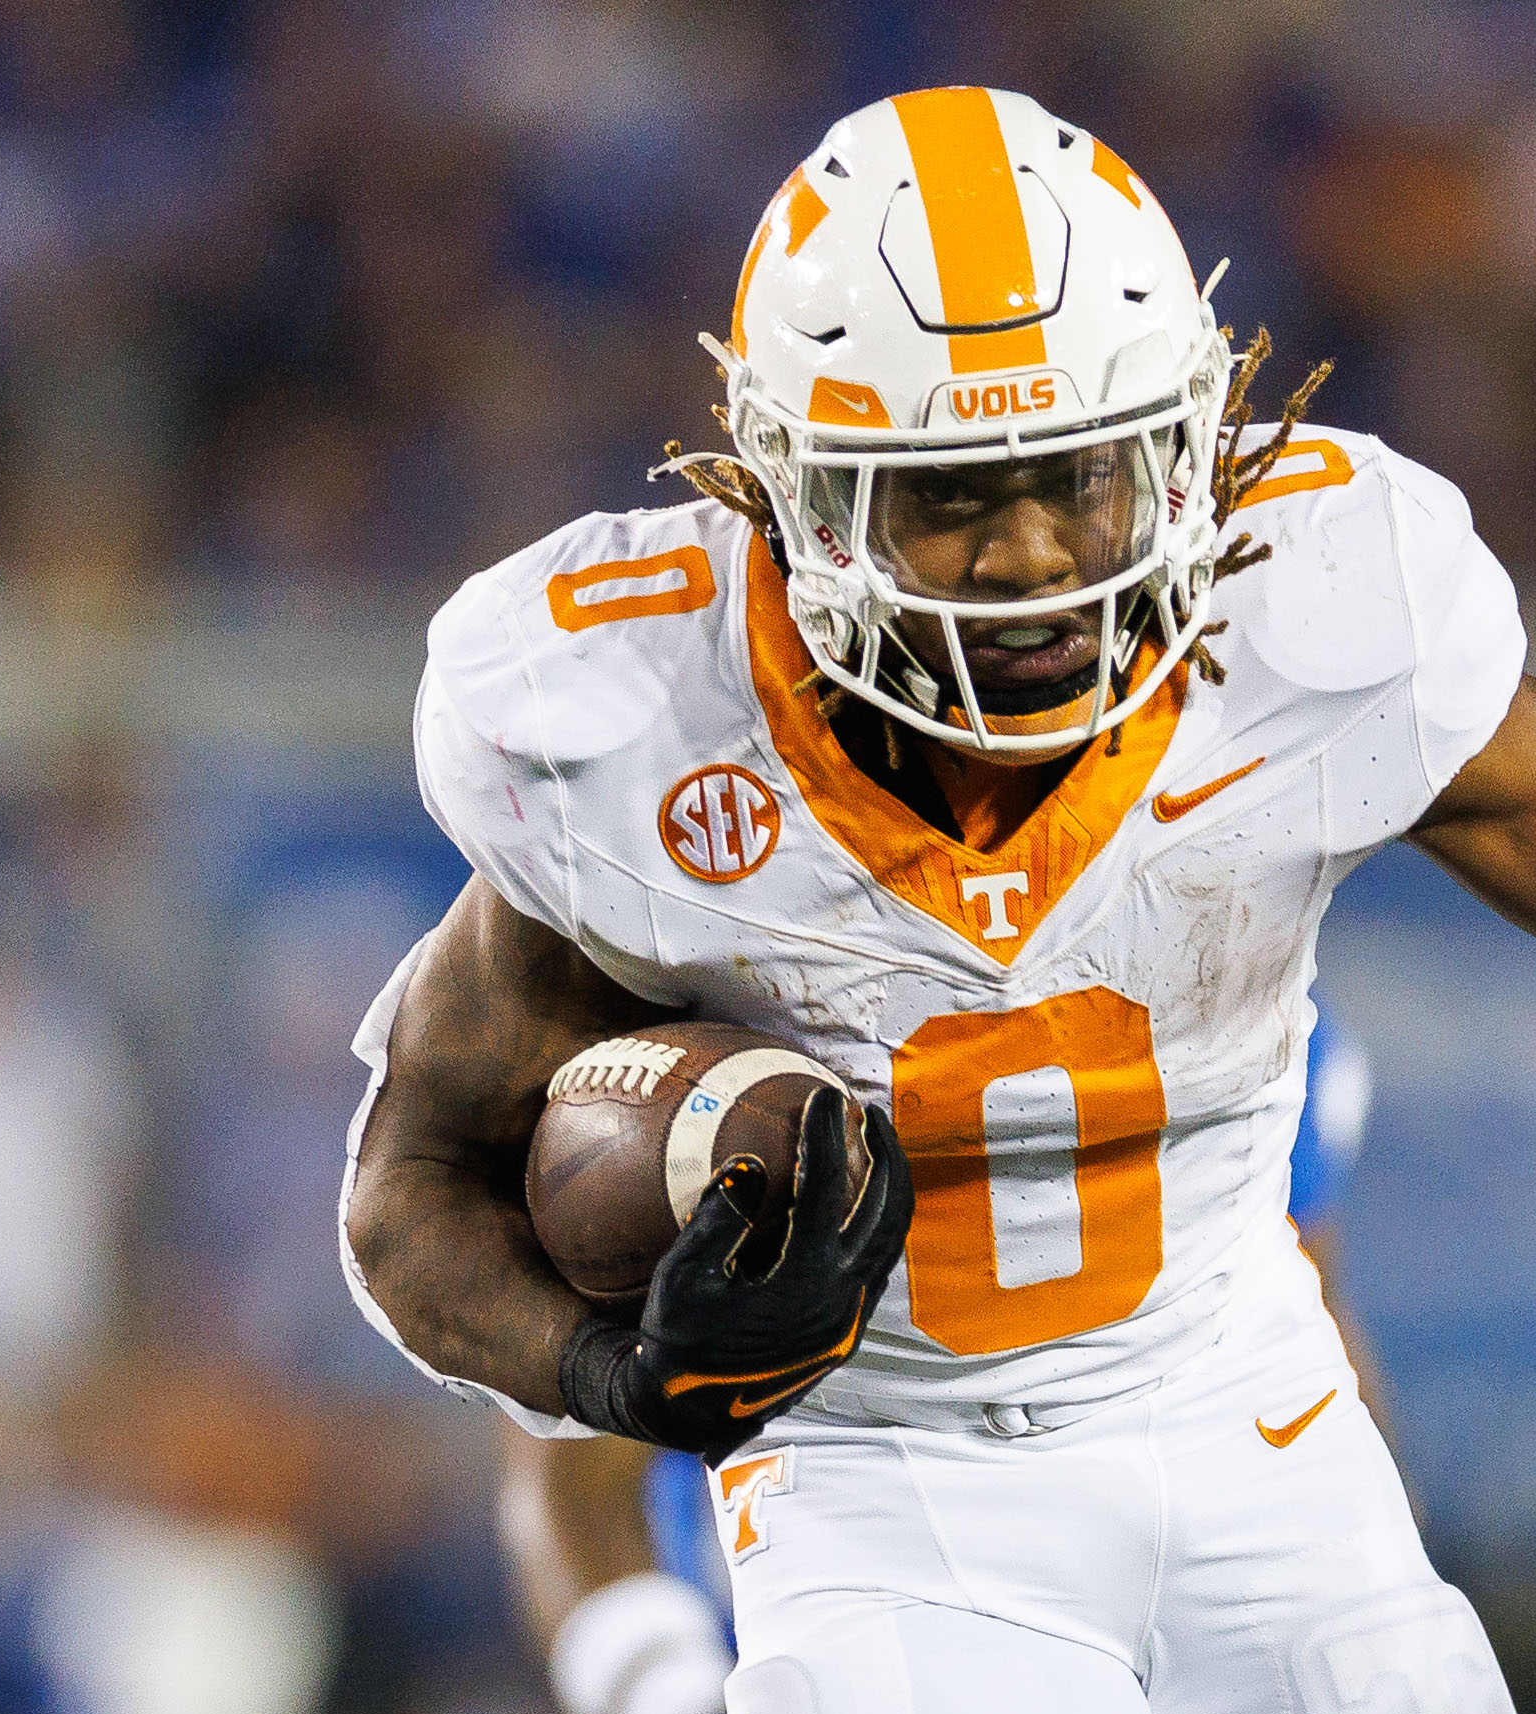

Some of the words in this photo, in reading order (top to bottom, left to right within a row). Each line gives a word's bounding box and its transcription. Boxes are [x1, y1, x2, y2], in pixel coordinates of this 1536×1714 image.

[952, 377, 1056, 420] VOLS
[545, 544, 717, 634] 0
[665, 770, 775, 876] SEC
[961, 870, 1029, 941] T
[892, 984, 1167, 1357] 0
[718, 1447, 791, 1560] T
